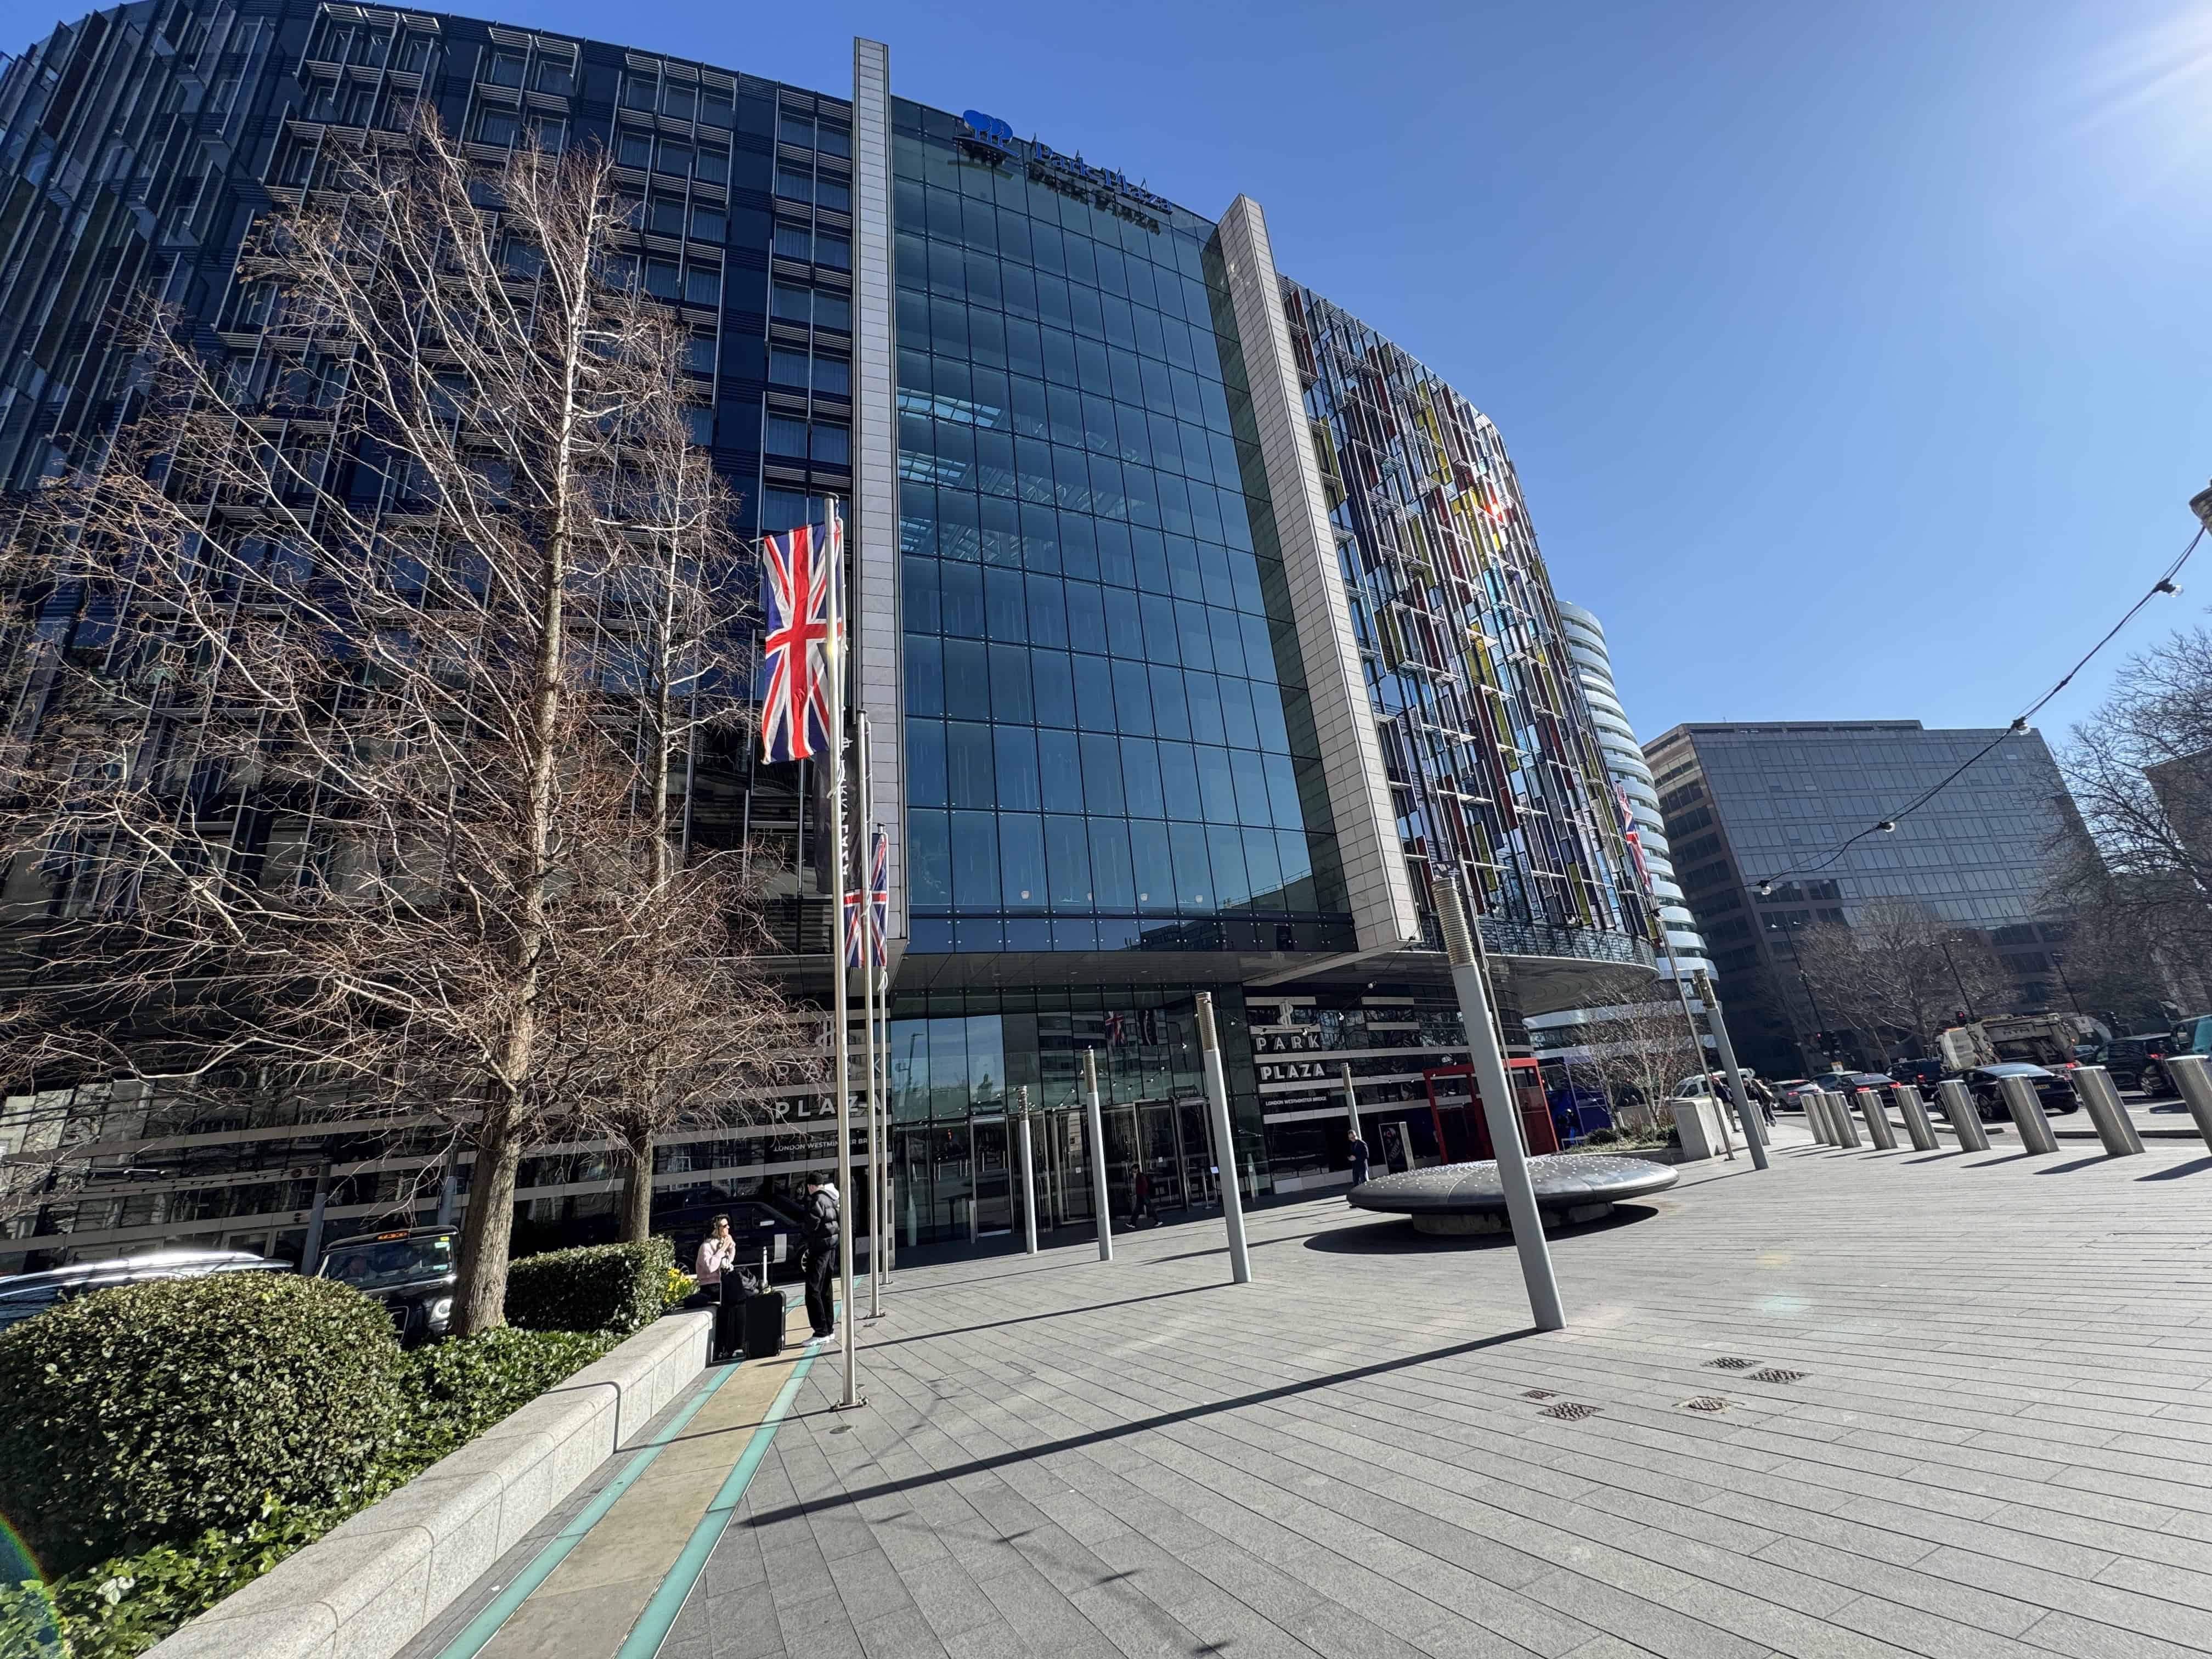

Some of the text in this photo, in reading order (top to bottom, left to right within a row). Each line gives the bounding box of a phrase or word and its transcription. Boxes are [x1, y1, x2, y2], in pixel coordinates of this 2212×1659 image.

[1036, 141, 1172, 213] Park Plaza
[1256, 1035, 1320, 1051] PARK
[1260, 1063, 1325, 1080] PLAZA
[774, 1142, 805, 1152] LONDON
